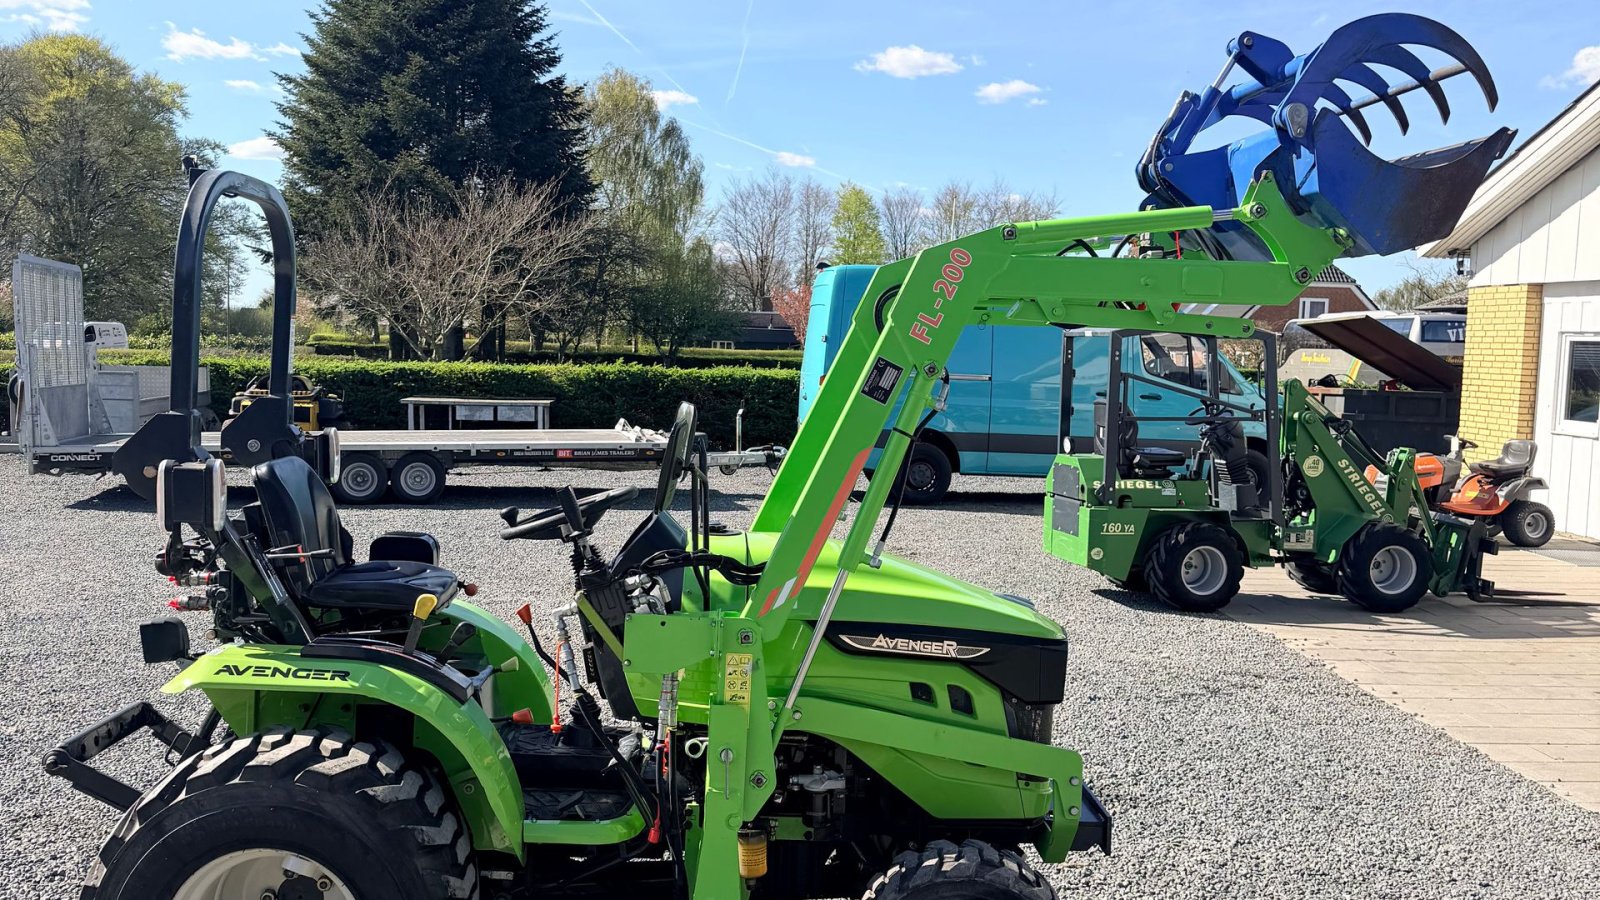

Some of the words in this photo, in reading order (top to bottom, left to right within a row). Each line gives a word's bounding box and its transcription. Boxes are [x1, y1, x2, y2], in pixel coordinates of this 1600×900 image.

[909, 247, 973, 345] FL-200
[1446, 327, 1466, 342] VI
[50, 454, 103, 462] CONNECT
[1092, 480, 1163, 489] SRIEGEL
[1337, 458, 1387, 518] STRIEGEL
[1102, 522, 1122, 533] 160
[1124, 524, 1135, 533] YA
[871, 633, 959, 658] AVENGER
[213, 664, 351, 682] AVENGER
